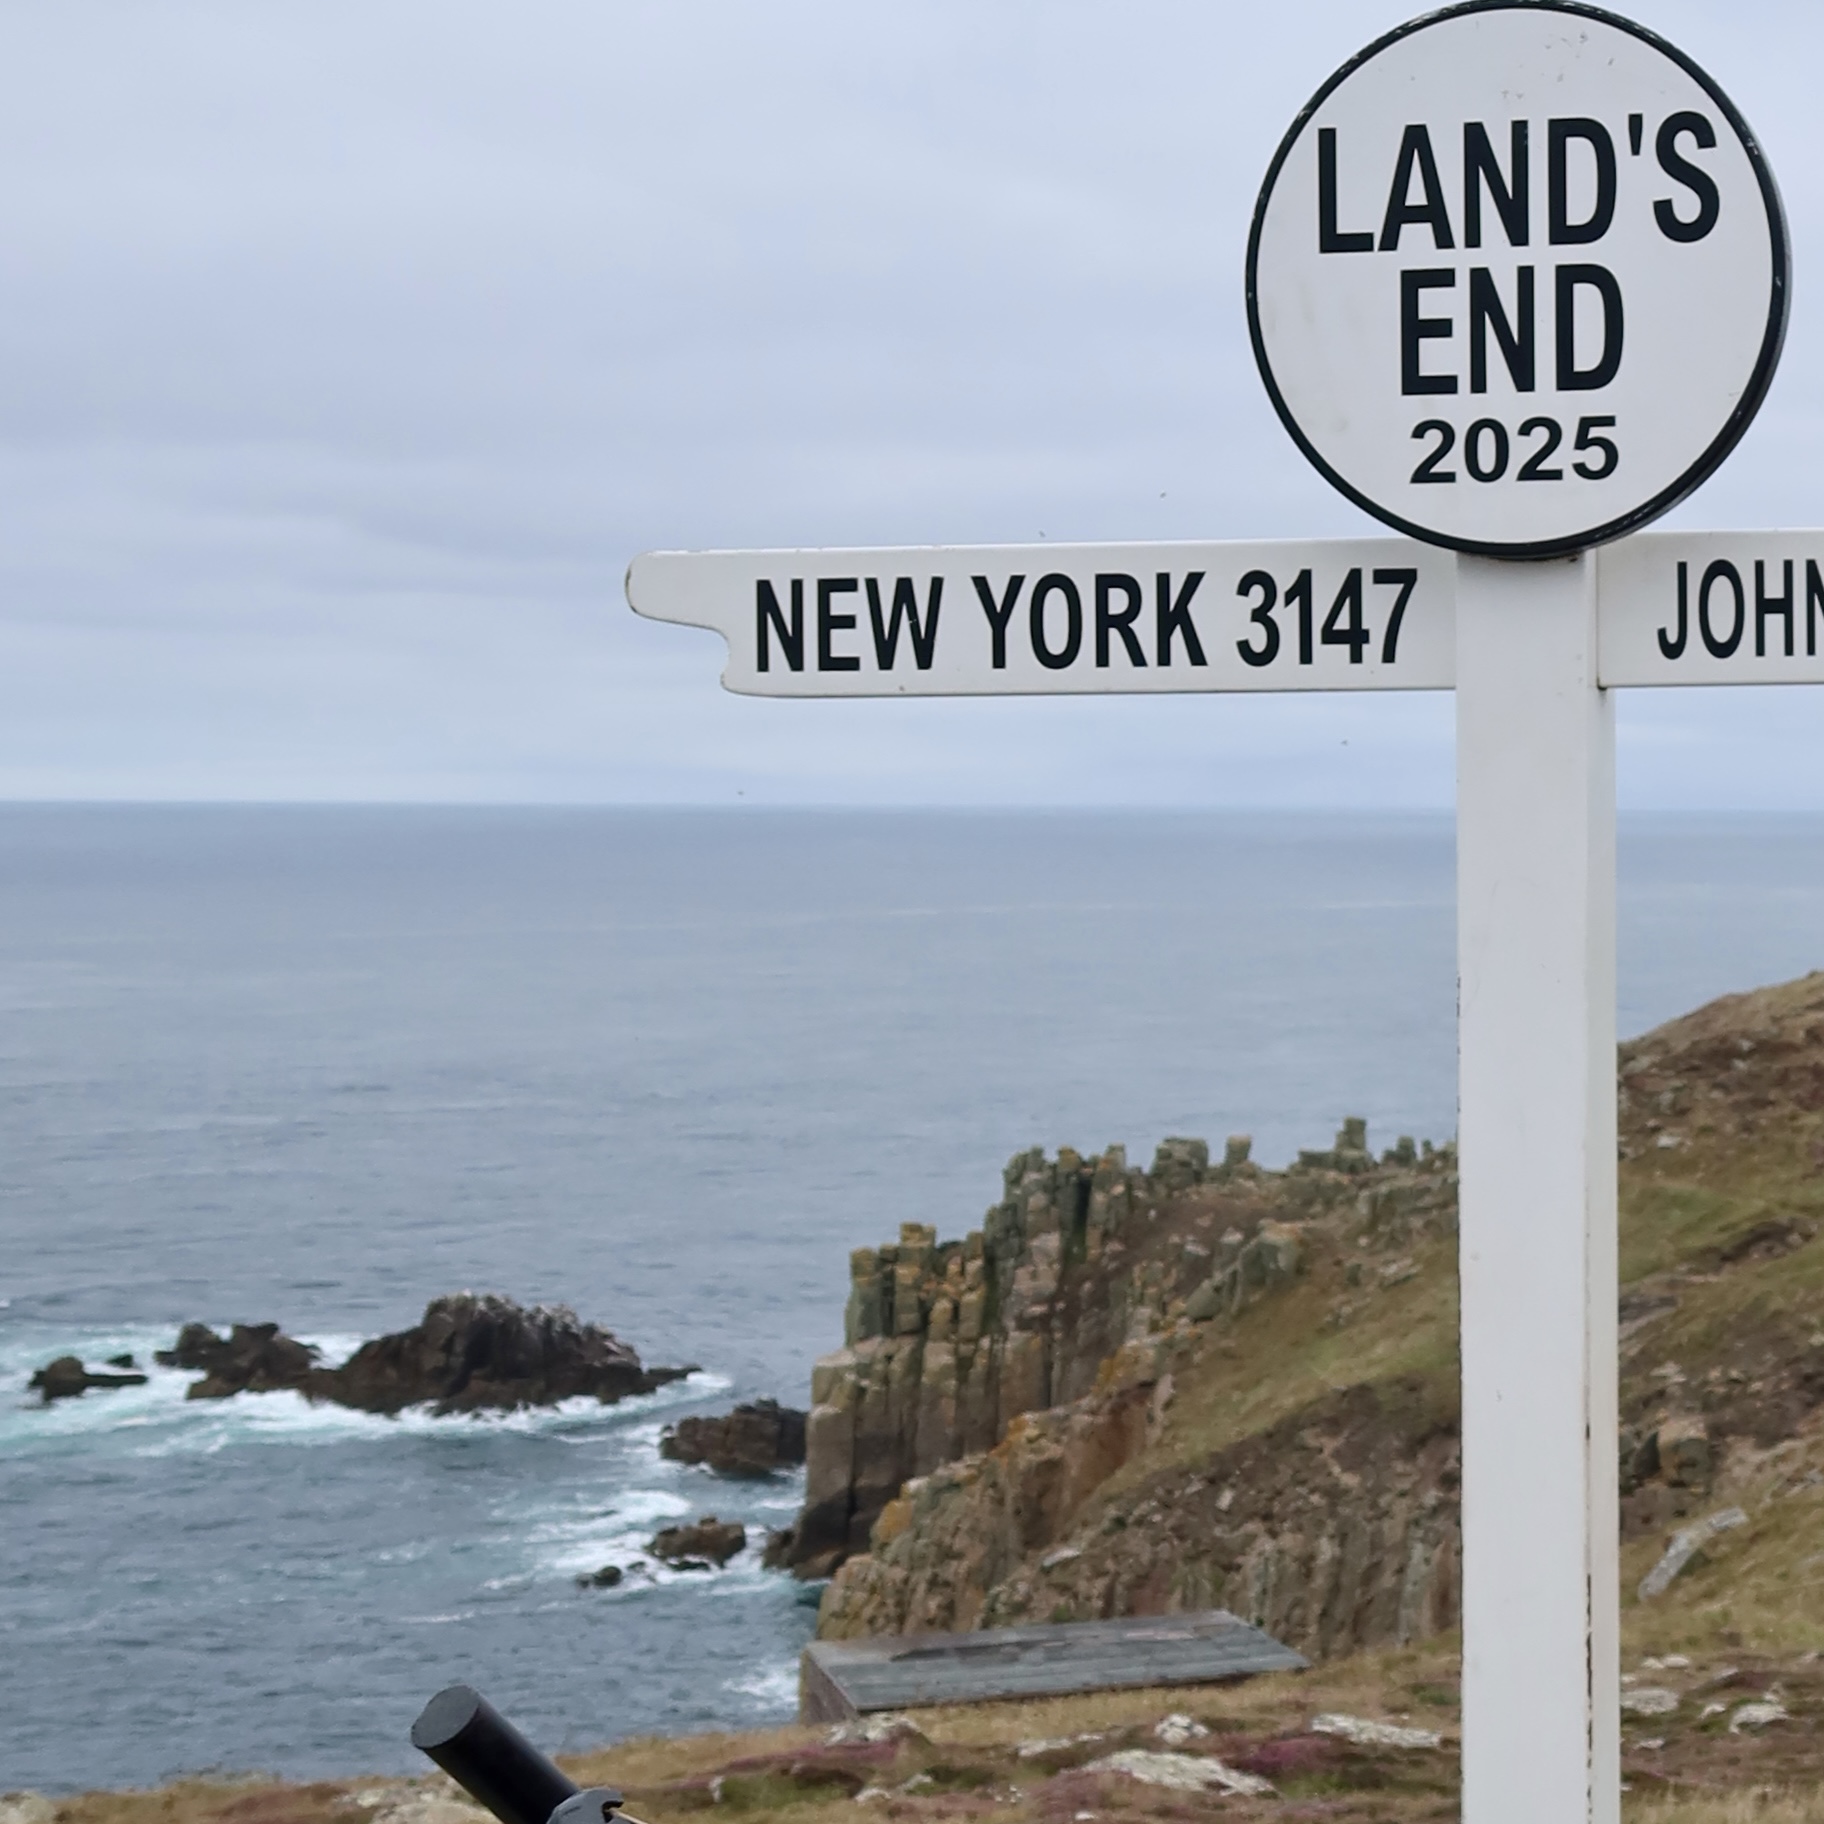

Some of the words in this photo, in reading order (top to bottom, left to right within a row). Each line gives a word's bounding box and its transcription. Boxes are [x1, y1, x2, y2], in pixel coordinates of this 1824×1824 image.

[1316, 109, 1722, 255] LAND'S
[1400, 263, 1624, 396] END
[1409, 415, 1619, 484] 2025
[756, 576, 945, 673] NEW
[970, 571, 1208, 670] YORK
[1236, 567, 1418, 668] 3147
